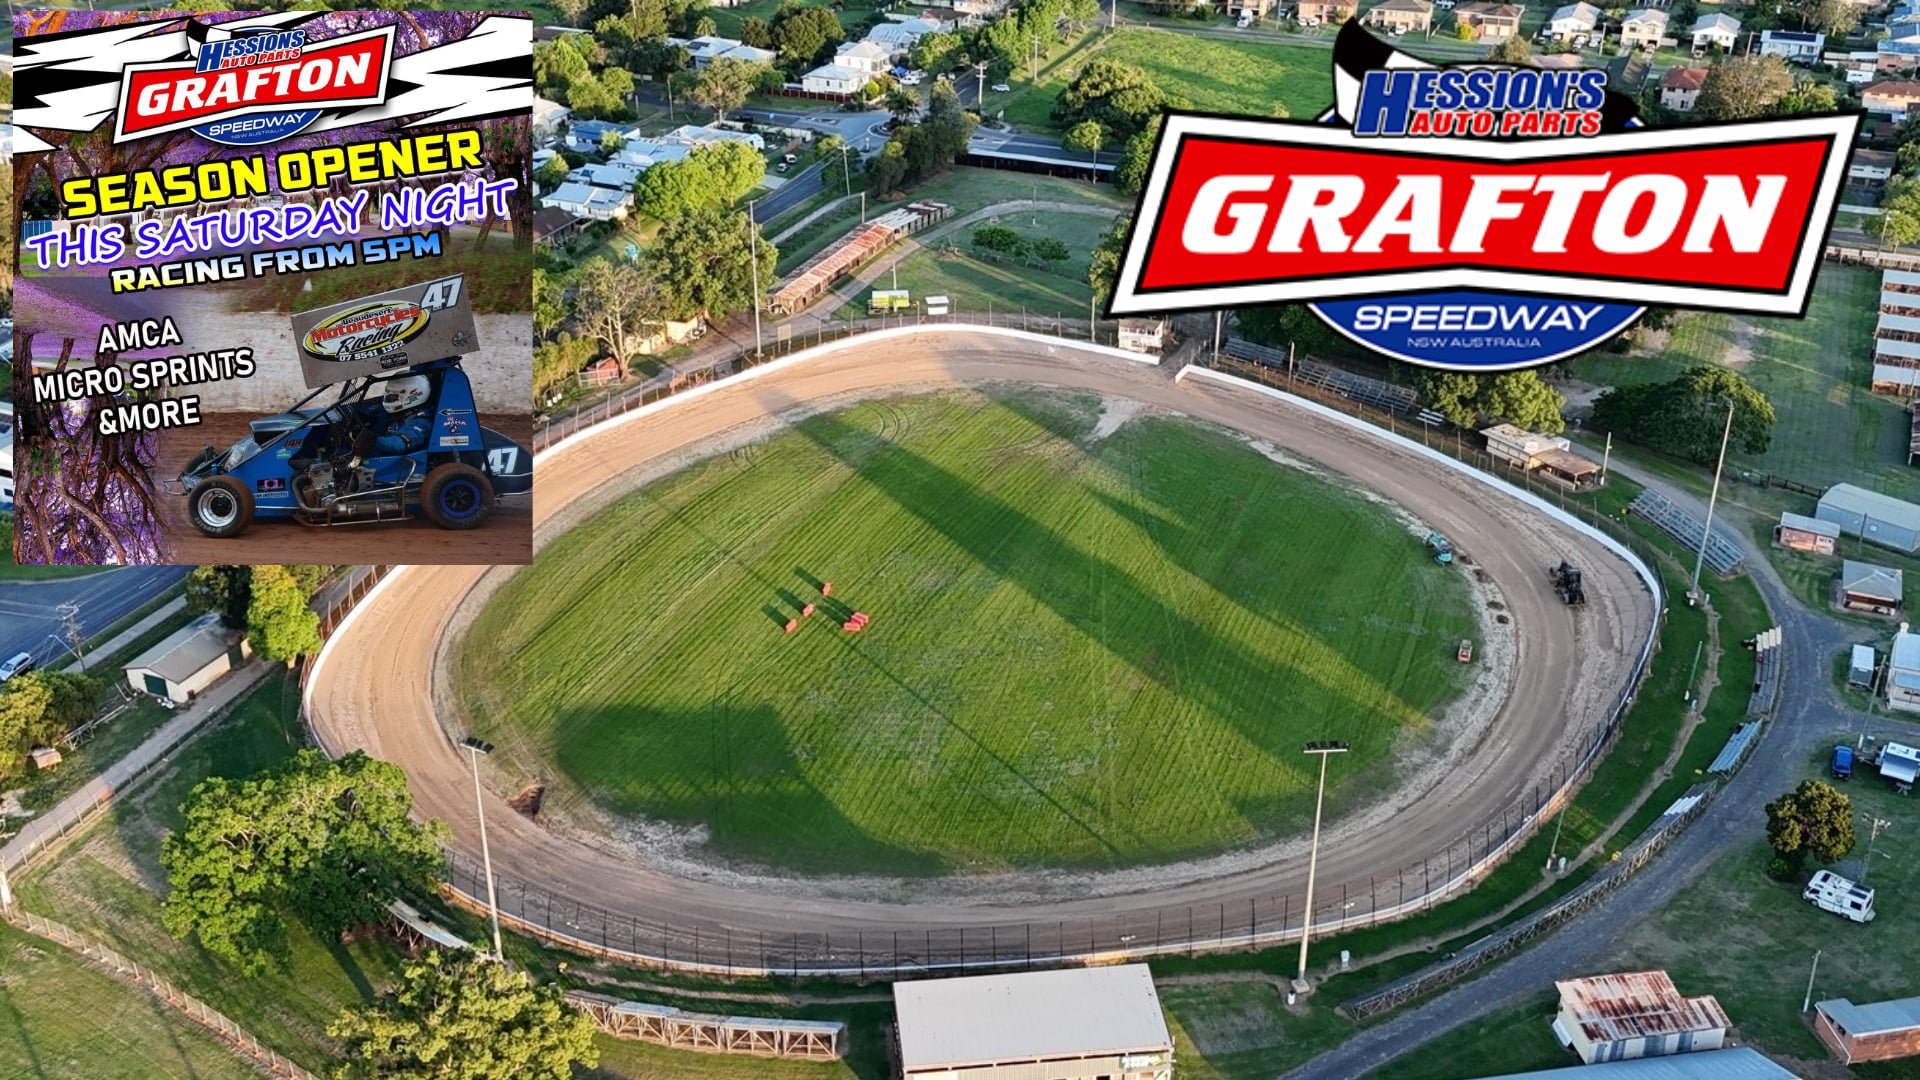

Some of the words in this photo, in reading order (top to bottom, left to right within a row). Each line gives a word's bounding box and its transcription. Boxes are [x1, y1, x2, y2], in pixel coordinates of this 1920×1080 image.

[419, 278, 463, 310] 47
[311, 306, 421, 343] Motorcycles
[336, 323, 402, 356] Racing
[339, 353, 350, 361] 07
[354, 351, 379, 360] 5541
[482, 447, 518, 475] 47
